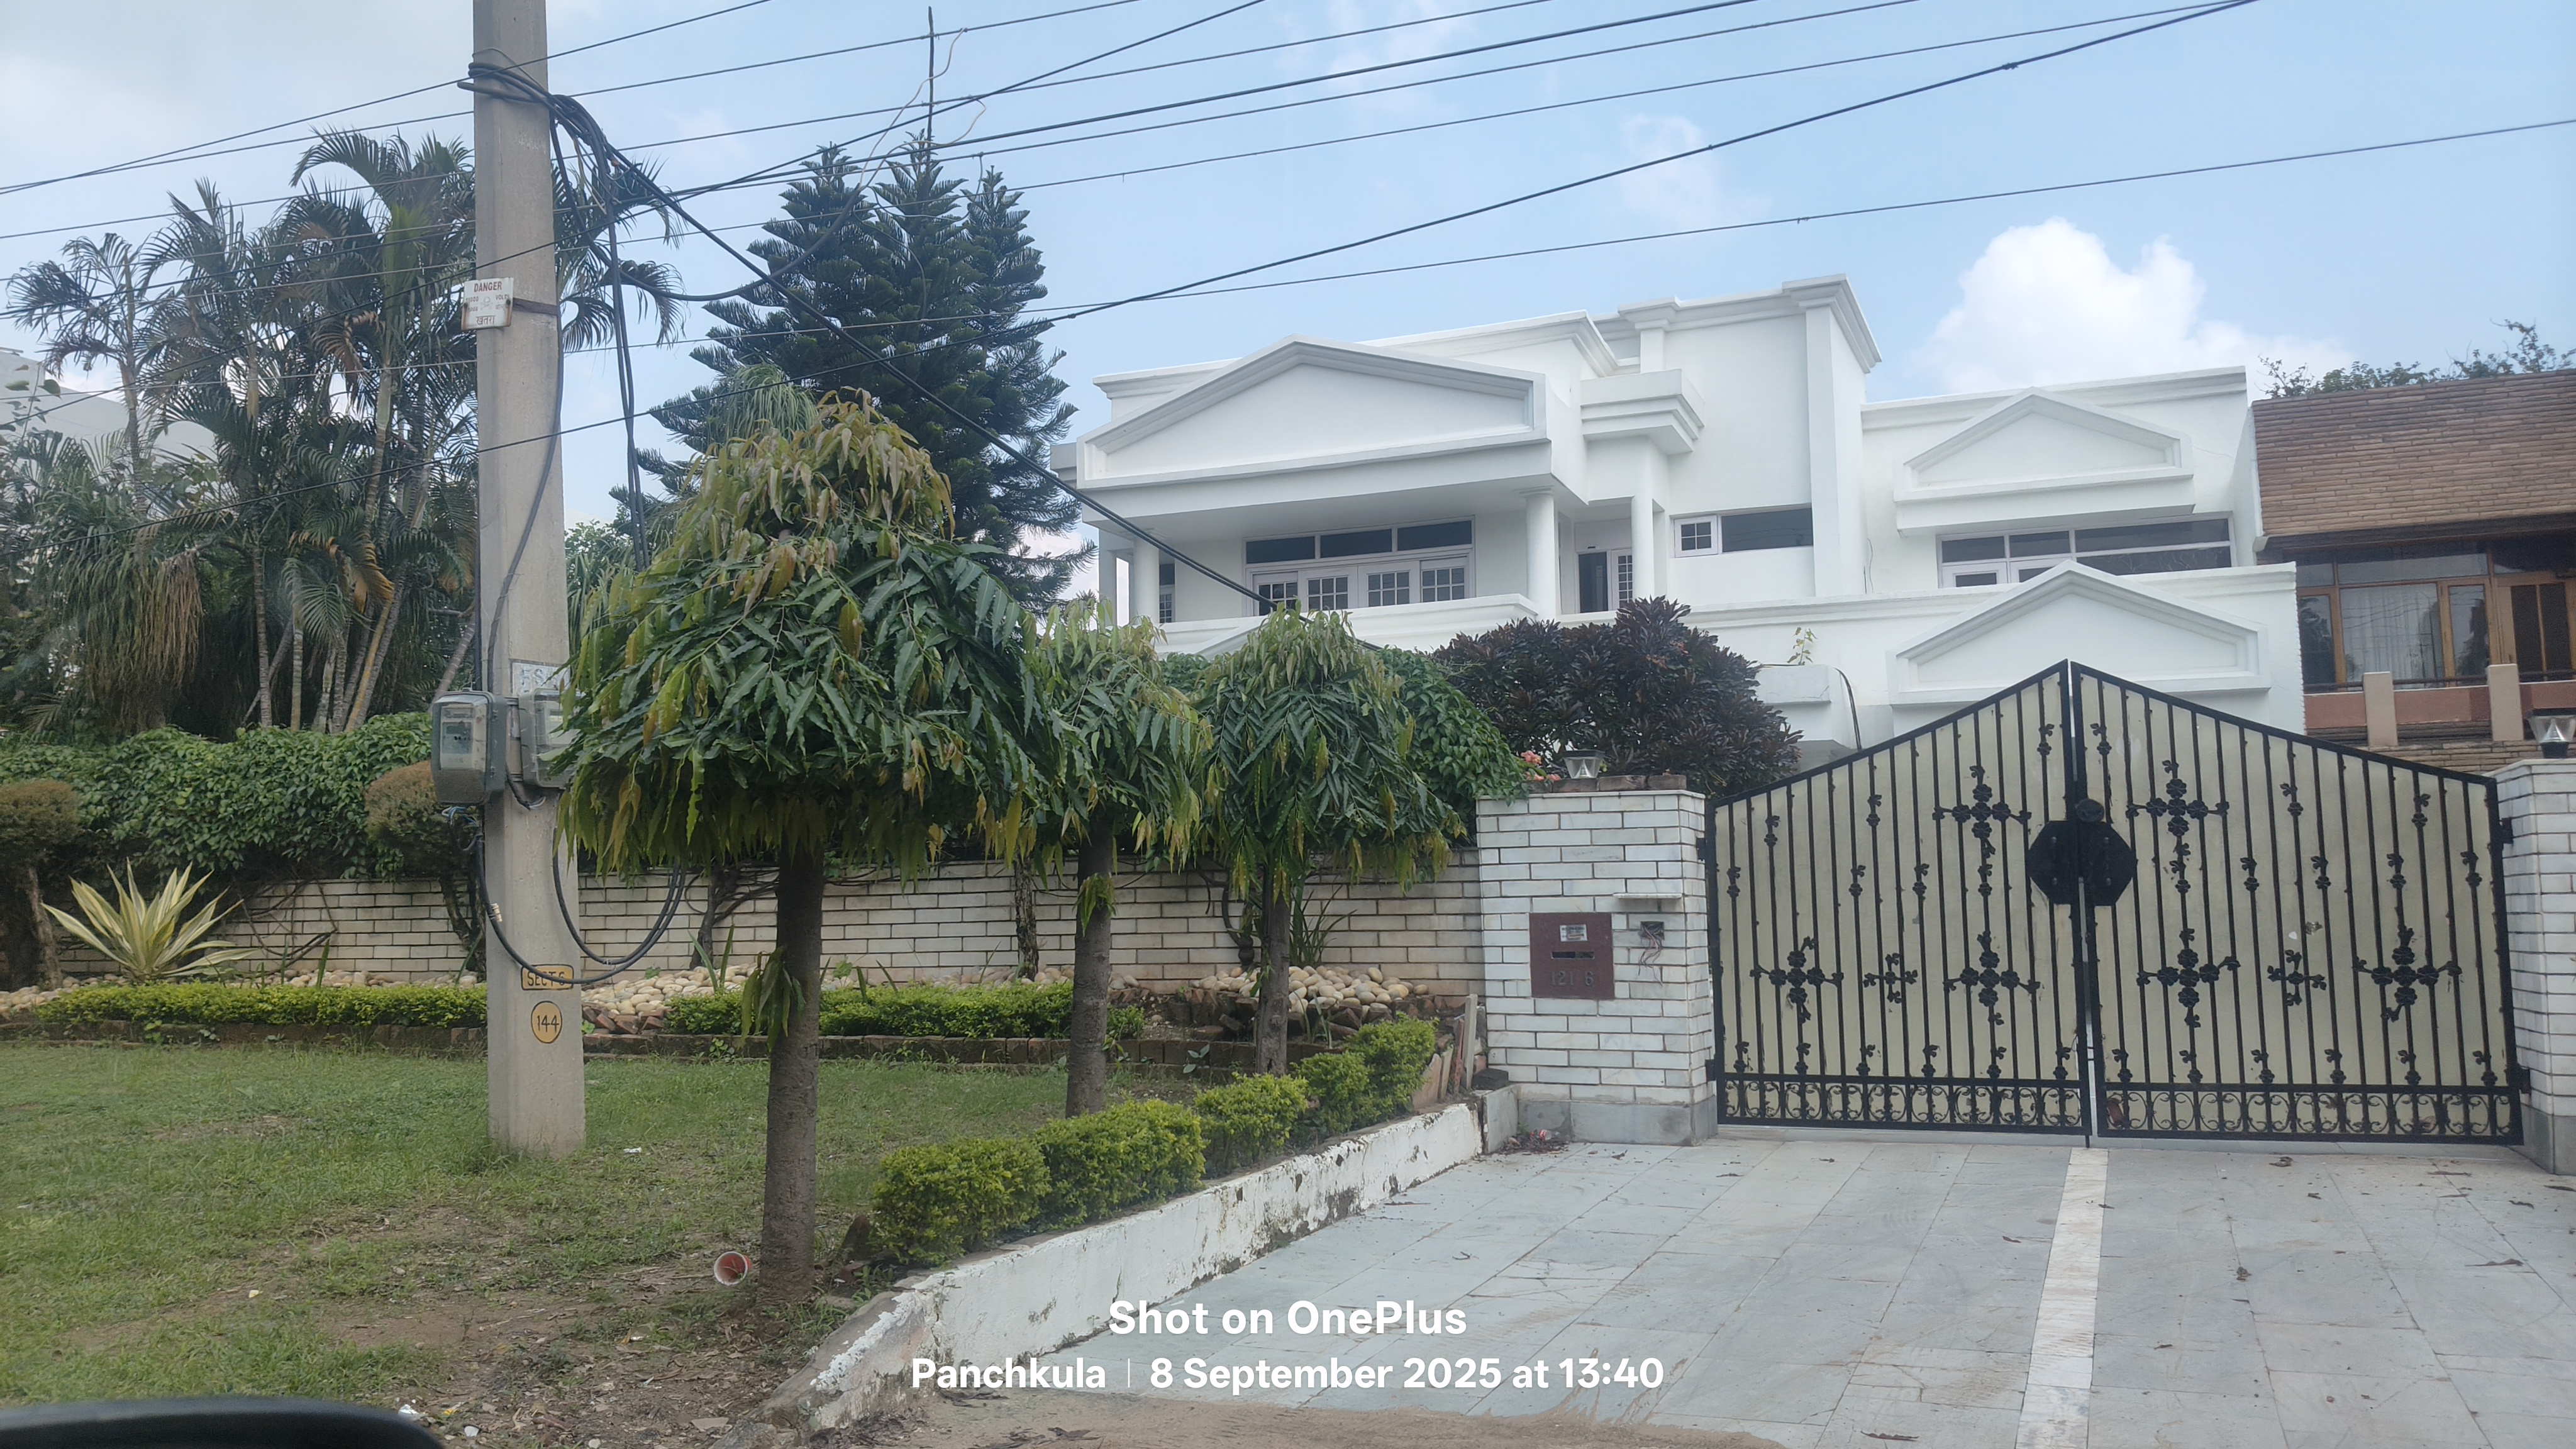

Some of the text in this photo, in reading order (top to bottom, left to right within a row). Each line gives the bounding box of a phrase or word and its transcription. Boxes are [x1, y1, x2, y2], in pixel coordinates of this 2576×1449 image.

[474, 281, 502, 292] DANGER
[475, 315, 496, 326] खतरा
[536, 1014, 560, 1033] 144
